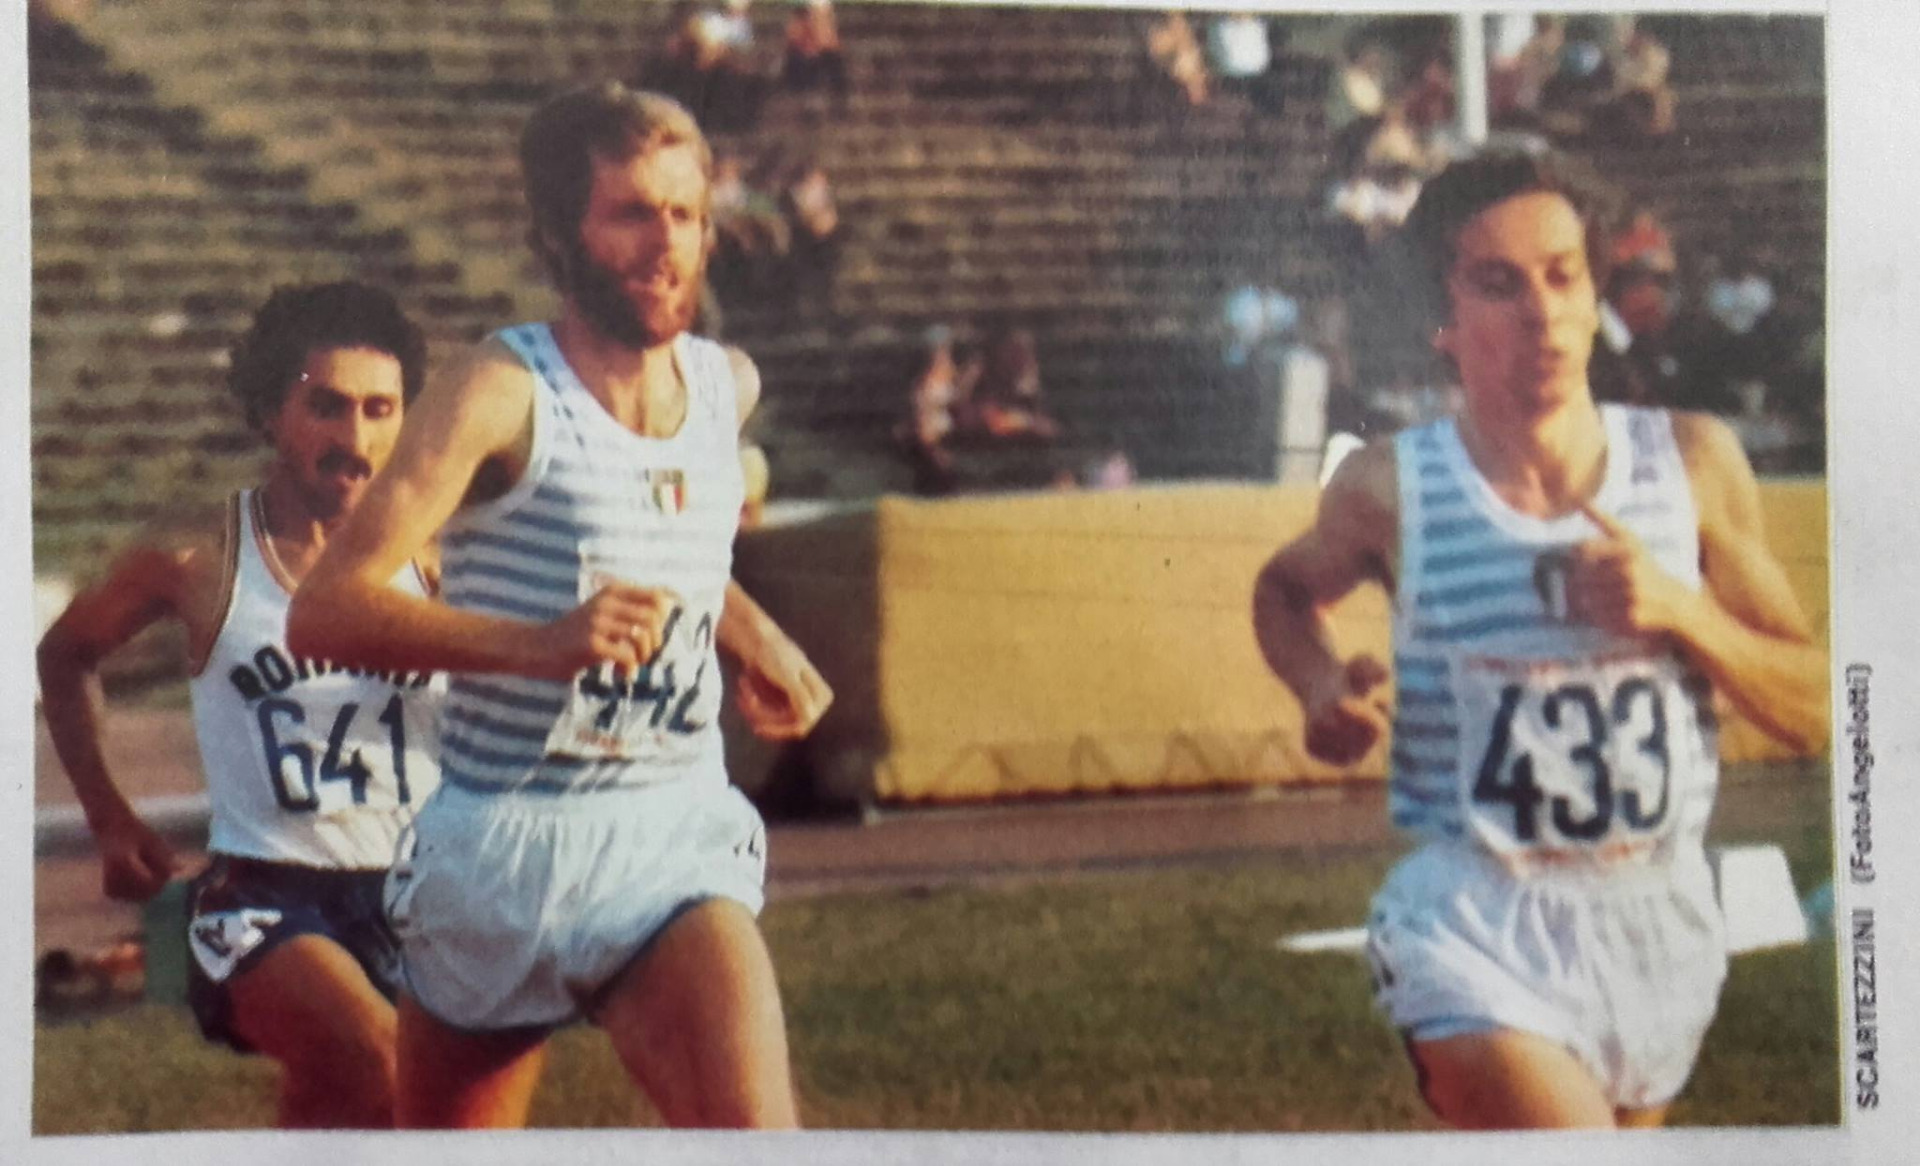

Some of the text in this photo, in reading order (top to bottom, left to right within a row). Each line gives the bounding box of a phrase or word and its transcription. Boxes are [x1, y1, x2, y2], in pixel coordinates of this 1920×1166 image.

[256, 692, 414, 812] 641
[1472, 676, 1671, 842] 433
[1852, 909, 1880, 1110] SCARTEZZINI
